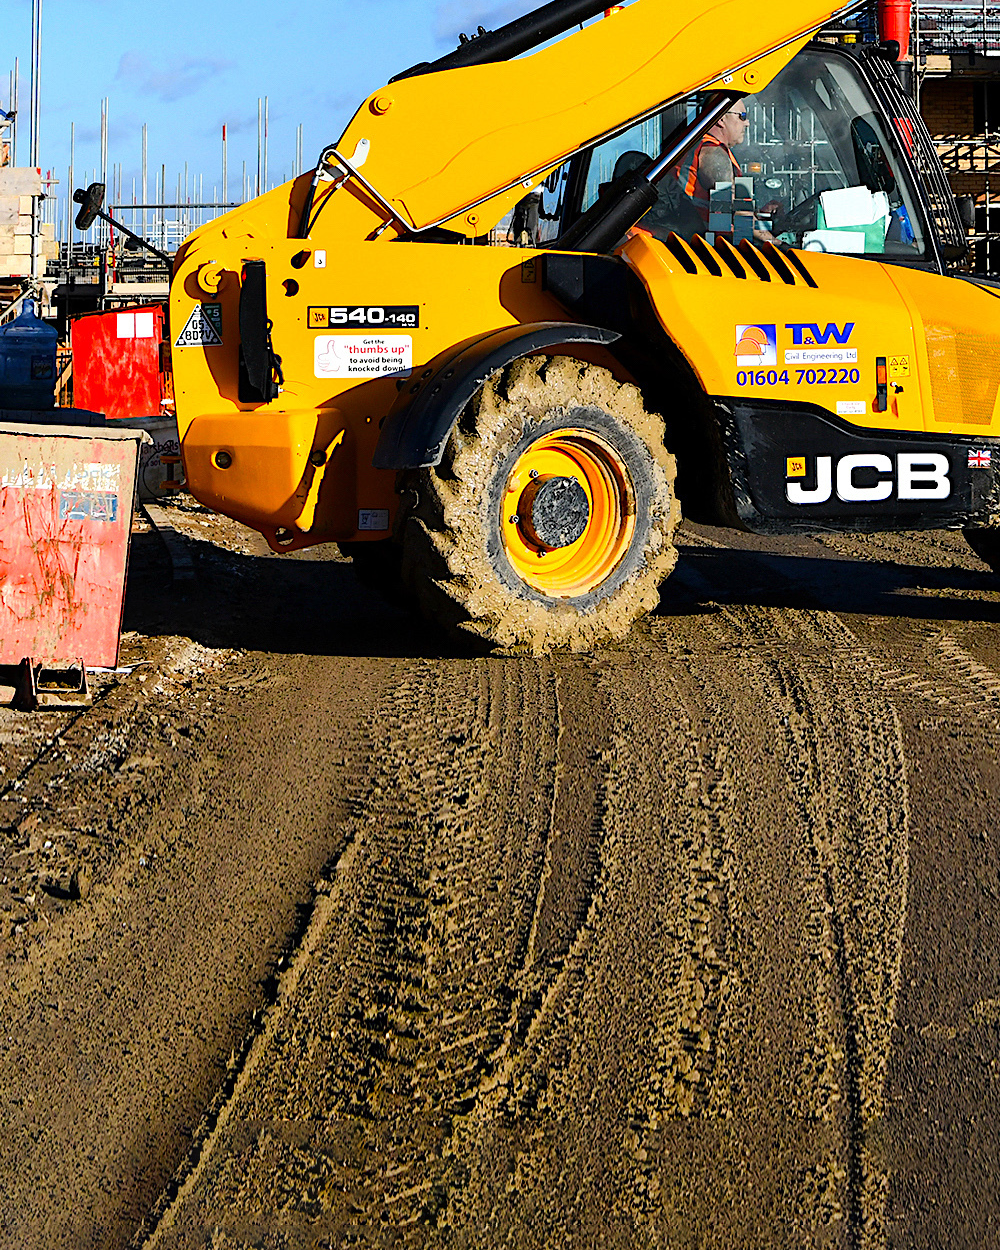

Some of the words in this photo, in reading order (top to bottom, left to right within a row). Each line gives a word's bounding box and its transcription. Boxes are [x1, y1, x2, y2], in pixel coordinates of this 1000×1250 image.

[784, 322, 855, 345] T&W
[344, 345, 389, 354] "thumbs
[391, 344, 410, 355] up"
[785, 352, 800, 361] Civil
[802, 352, 843, 362] Engineering
[846, 352, 857, 360] Ltd
[359, 356, 380, 364] avoid
[381, 356, 403, 365] being
[736, 369, 790, 387] 01604
[796, 368, 860, 385] 702220
[785, 453, 951, 505] JCB
